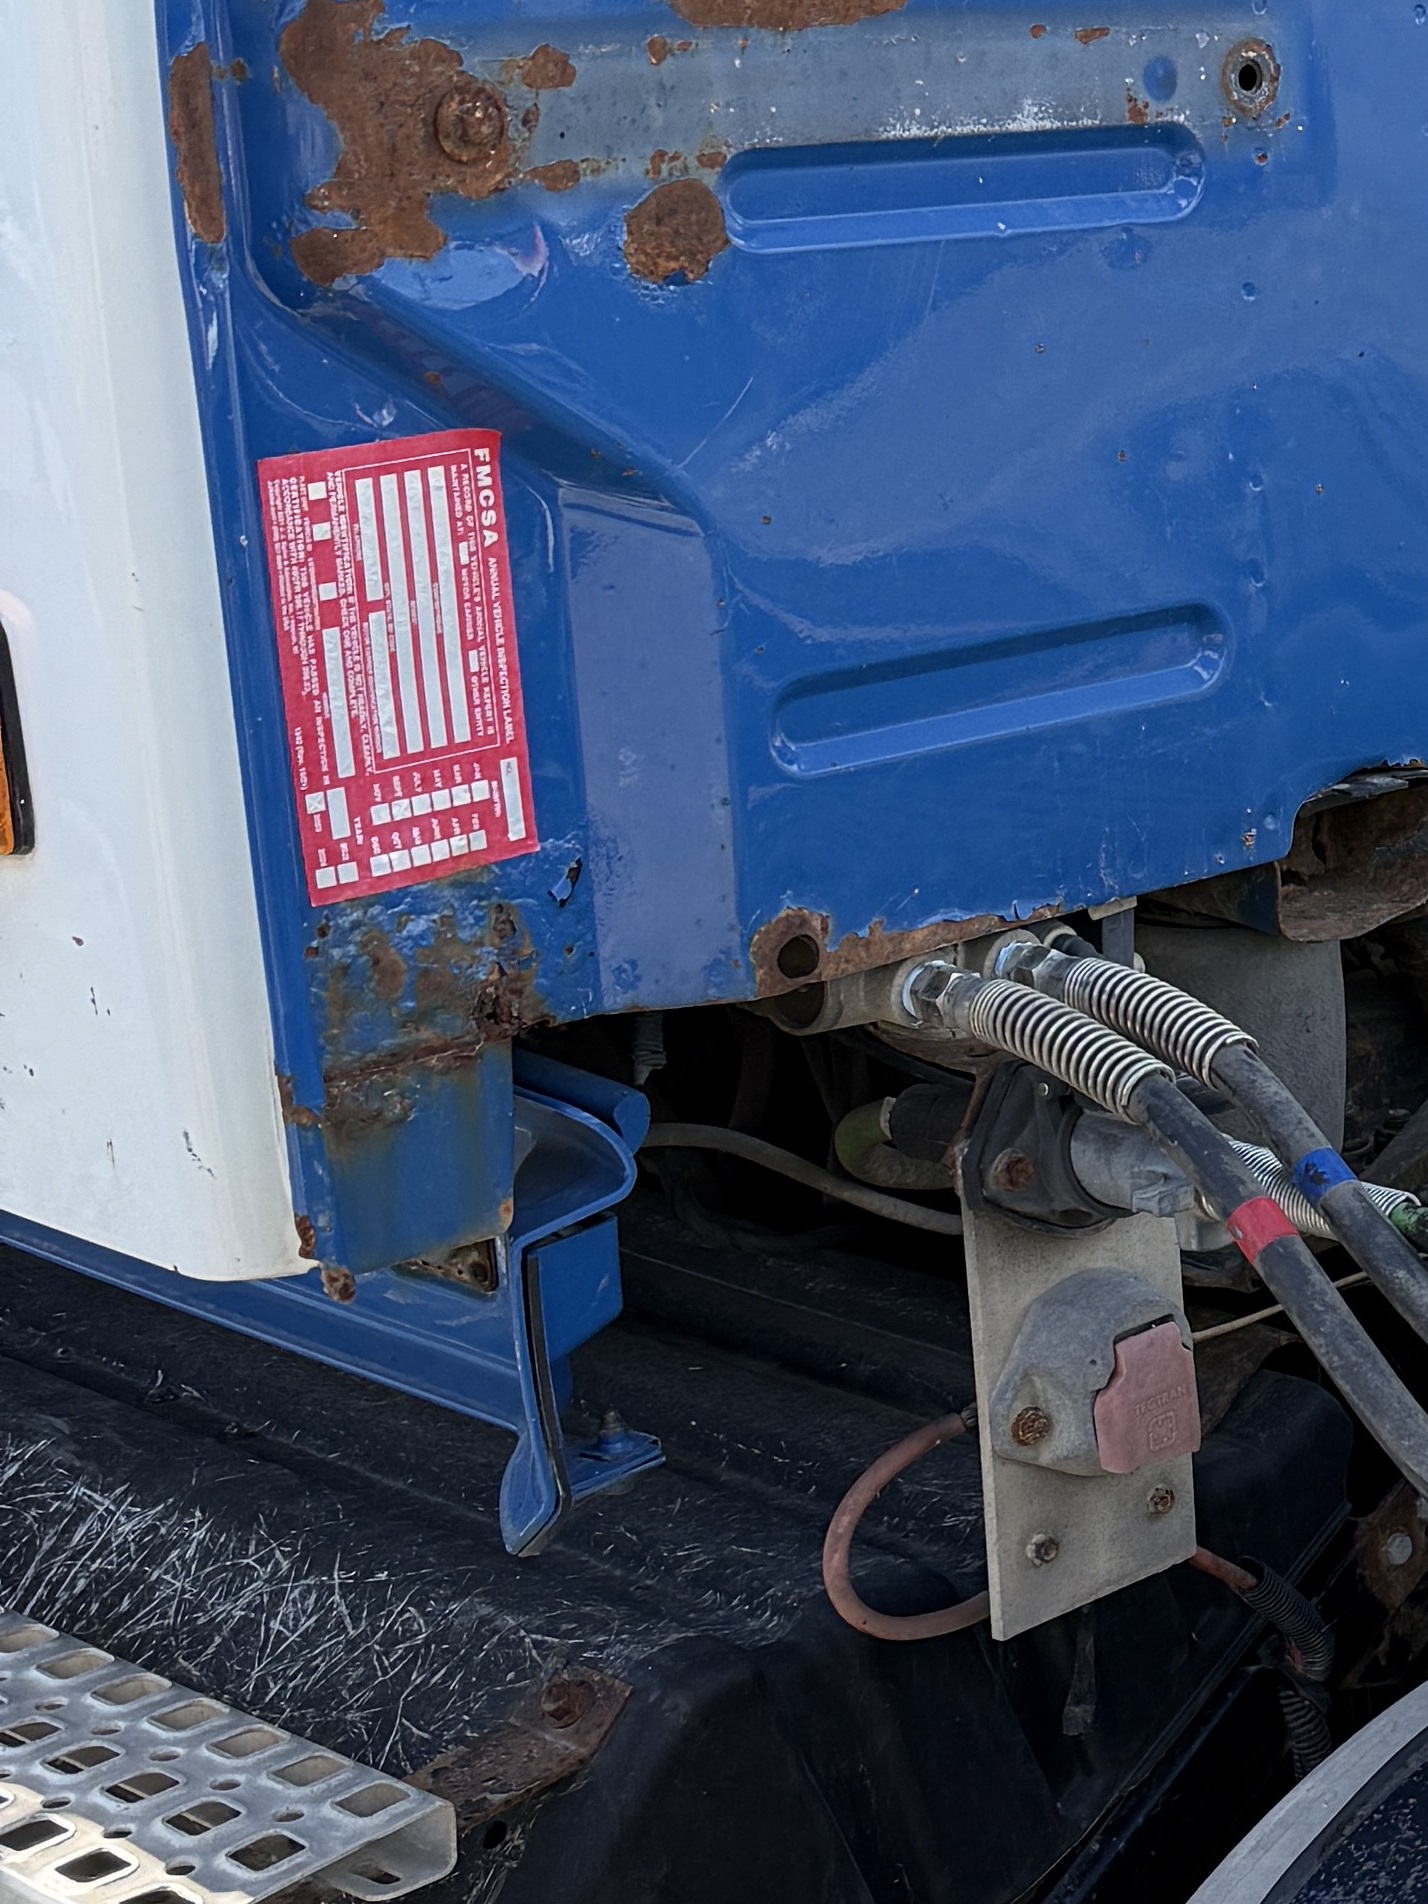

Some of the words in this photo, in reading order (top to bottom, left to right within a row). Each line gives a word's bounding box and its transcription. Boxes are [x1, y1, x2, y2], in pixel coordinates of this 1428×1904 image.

[287, 476, 304, 562] CERTIFICATION:
[473, 447, 498, 547] FMCSA
[462, 473, 472, 512] RECORD
[478, 645, 489, 683] VEHICLE
[488, 557, 500, 600] ANNUAL
[492, 600, 504, 645] VEHICLE
[496, 647, 510, 708] INSPECTION
[502, 709, 514, 743] LABEL
[1134, 1384, 1187, 1417] TECTRAN
